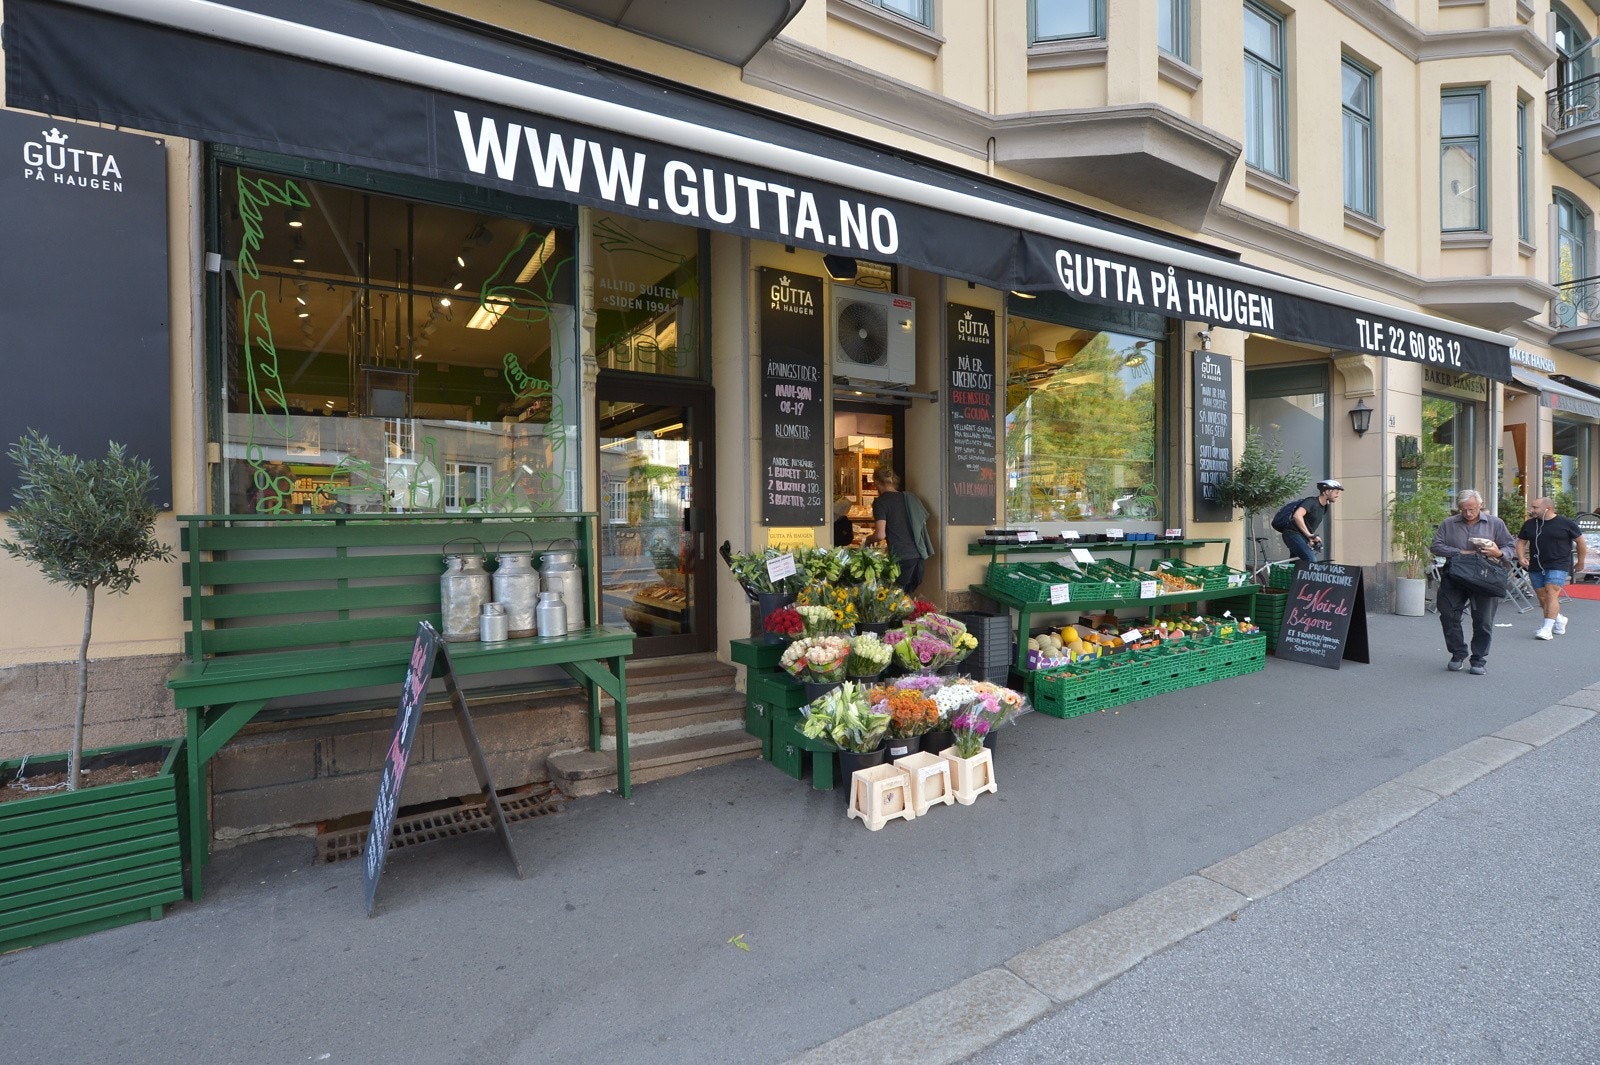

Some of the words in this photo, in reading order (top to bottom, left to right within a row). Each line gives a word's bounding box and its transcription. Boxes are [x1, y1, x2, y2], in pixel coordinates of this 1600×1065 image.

[23, 141, 122, 179] GUTTA
[24, 167, 45, 181] PÅ
[54, 172, 123, 193] HAUGEN
[454, 110, 899, 255] WWW.GUTTA.NO
[600, 278, 636, 293] ALLTID
[639, 284, 679, 299] SULTEN
[771, 285, 813, 307] GUTTA
[1055, 249, 1144, 305] GUTTA
[1151, 265, 1182, 312] PÅ
[1187, 279, 1274, 329] HAUGEN
[771, 301, 780, 310] PÅ
[783, 304, 814, 316] HAUGEN
[958, 319, 990, 337] GUTTA
[967, 335, 990, 345] HAUGEN
[1356, 318, 1385, 351] TLF.
[1388, 326, 1406, 356] 22
[1409, 330, 1426, 360] 60
[1428, 335, 1445, 363] 85
[1446, 339, 1461, 367] 12
[958, 355, 971, 372] NÅ
[972, 358, 984, 373] ER
[1509, 347, 1531, 365] AKER
[1531, 353, 1556, 372] HANSEN
[1201, 362, 1221, 376] GUTTA
[1207, 374, 1221, 382] HAUGEN
[952, 371, 977, 389] UKENS
[978, 373, 993, 390] OST
[1424, 368, 1452, 387] BAKER
[1453, 374, 1486, 395] HANSEN
[952, 390, 991, 406] BEEMSTER
[780, 401, 804, 416] 08-19
[964, 407, 990, 421] GOUDA
[768, 466, 773, 477] 1
[774, 467, 801, 480] BUKETT
[768, 479, 774, 490] 2
[768, 493, 775, 505] 3
[1309, 562, 1328, 572] PRØV
[1329, 564, 1346, 574] VÅR
[1297, 583, 1314, 601] Le
[1303, 587, 1336, 613] Noir
[1334, 598, 1348, 616] de
[1287, 607, 1333, 632] Bigorre
